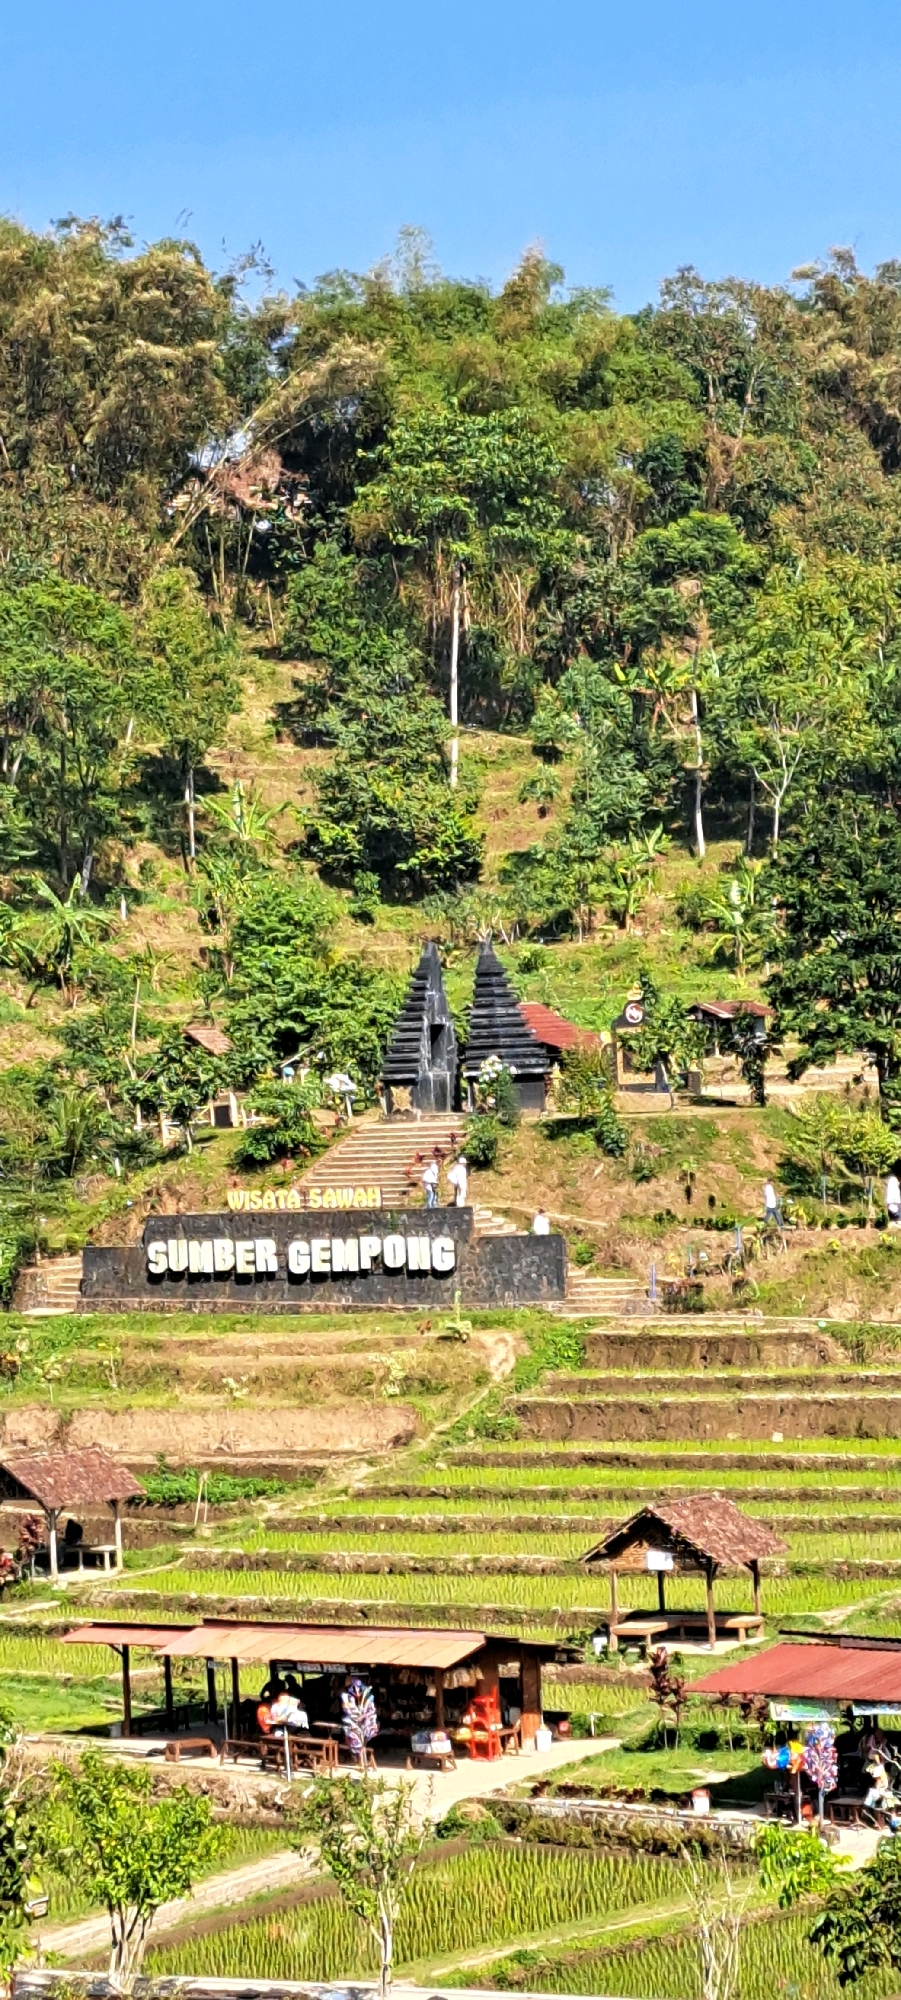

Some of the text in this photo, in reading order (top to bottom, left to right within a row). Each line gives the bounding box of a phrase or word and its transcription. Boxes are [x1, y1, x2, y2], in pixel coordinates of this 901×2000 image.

[227, 1187, 381, 1210] WISATA SAWAH
[148, 1235, 455, 1274] SUMBER GEMPONG
